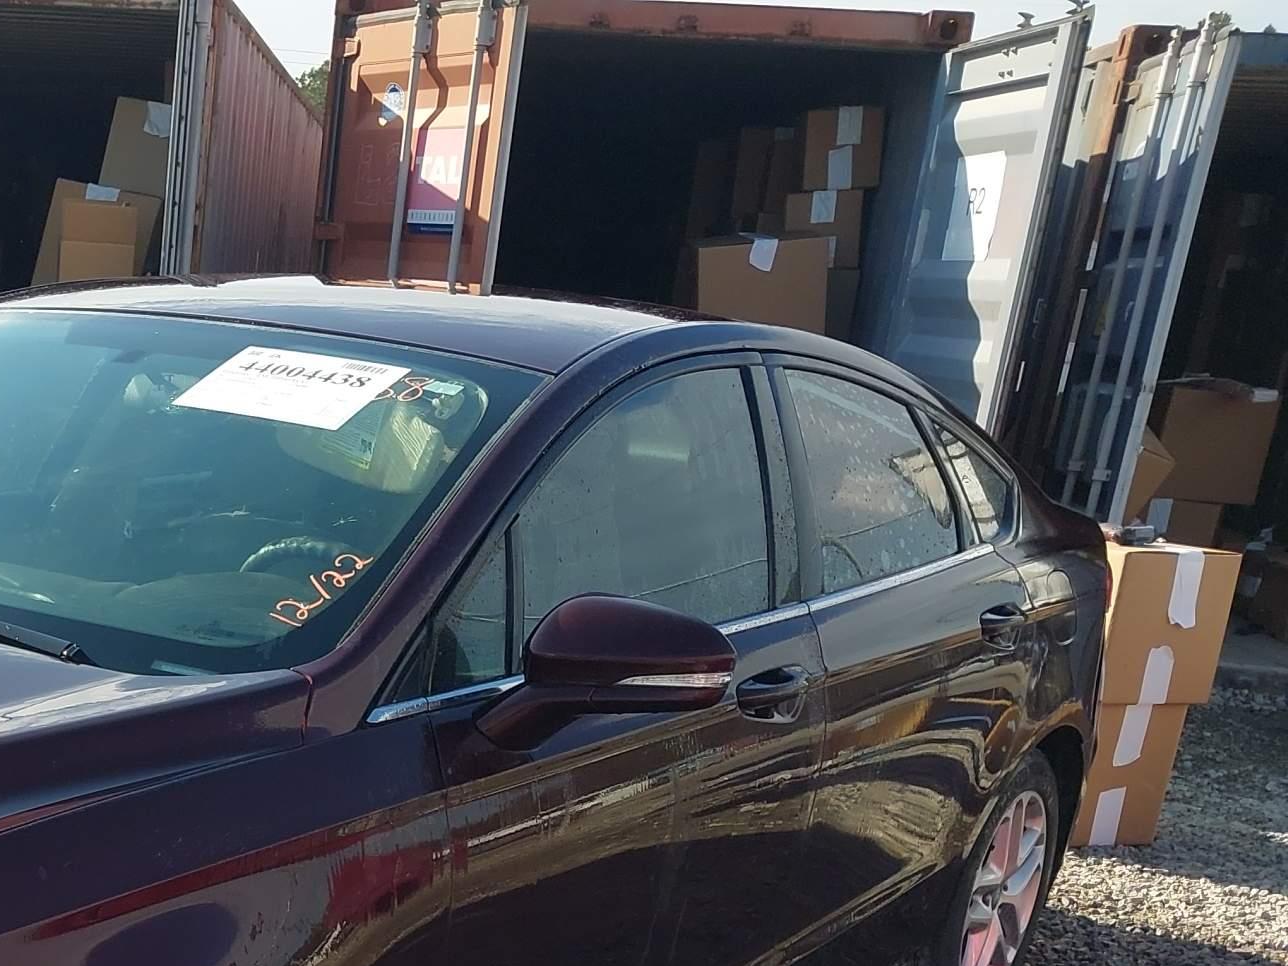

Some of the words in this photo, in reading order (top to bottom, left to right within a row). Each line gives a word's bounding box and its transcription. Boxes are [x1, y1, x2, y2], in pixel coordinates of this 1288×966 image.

[415, 155, 460, 185] TAL
[239, 360, 372, 388] 44004438
[269, 553, 374, 628] 12/22
